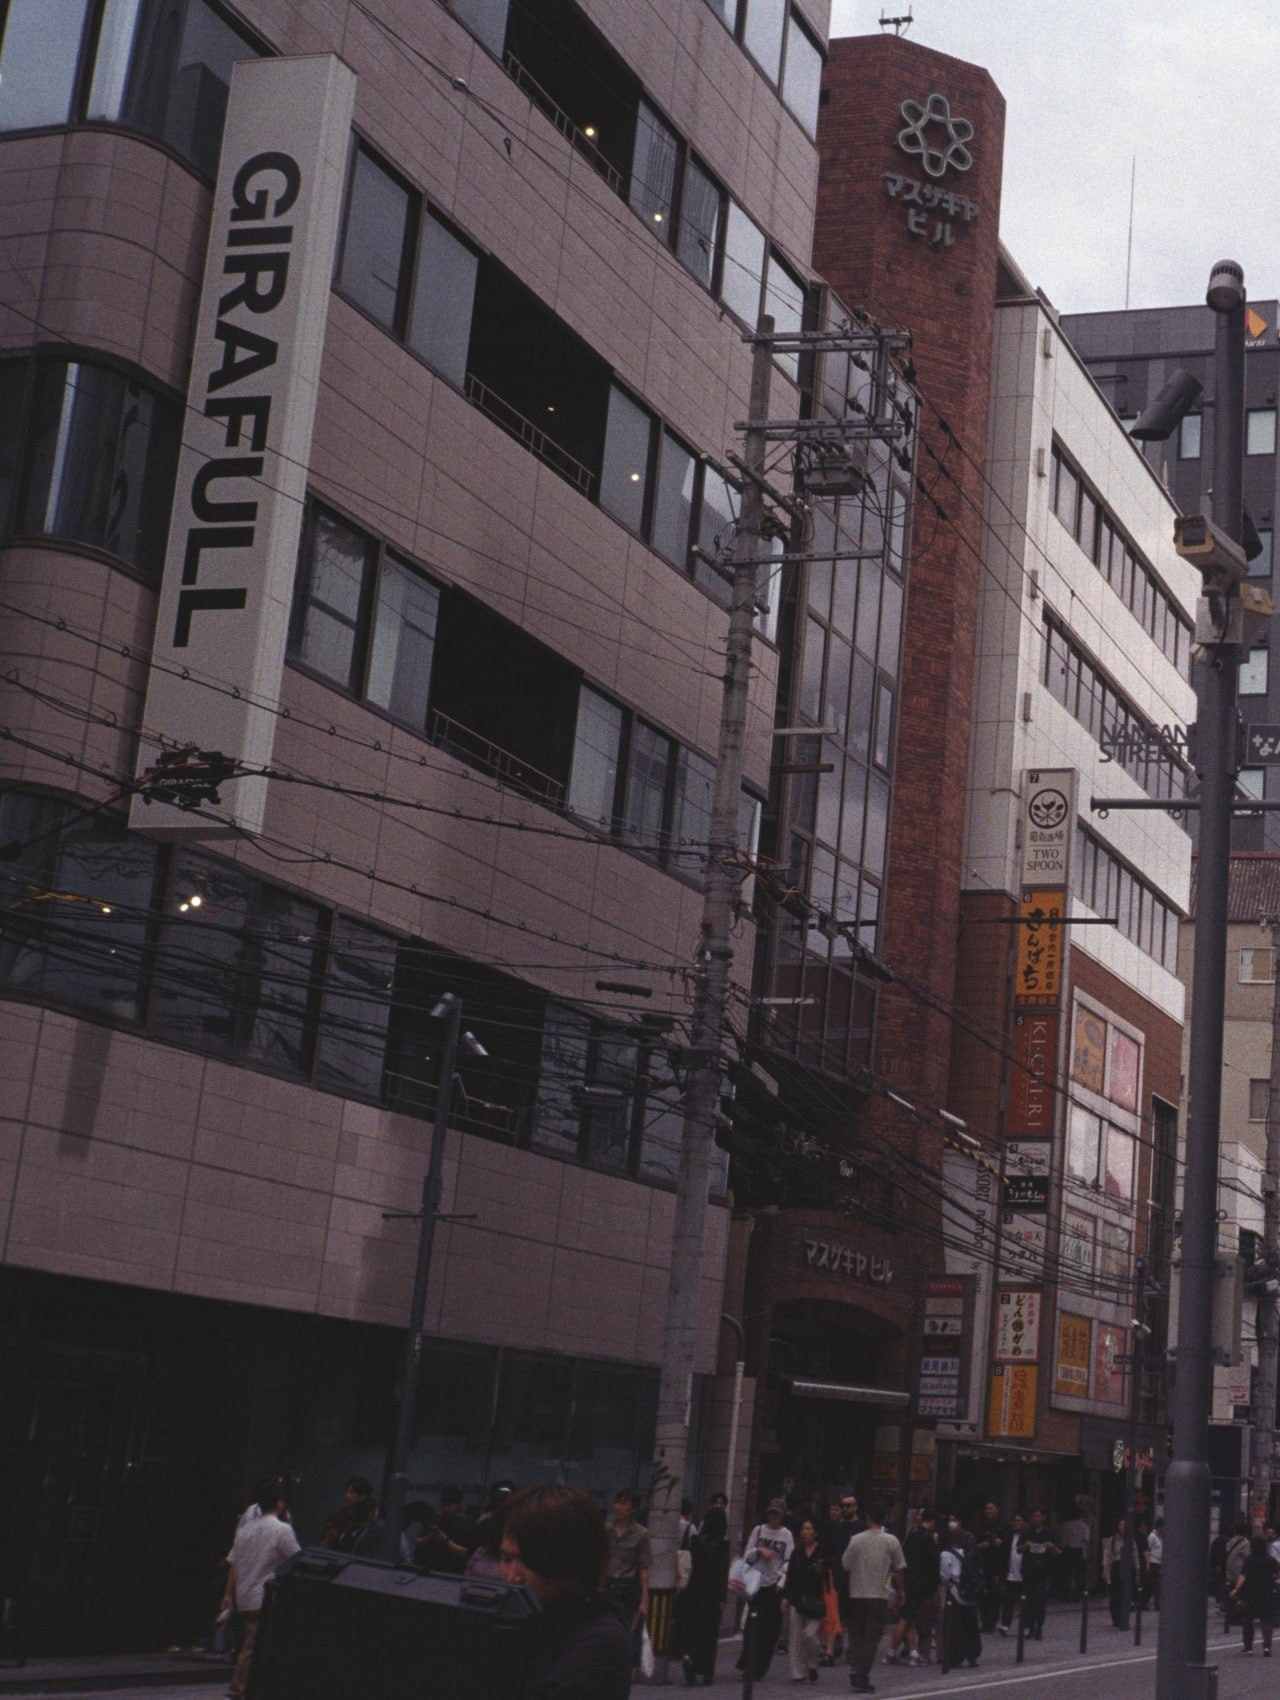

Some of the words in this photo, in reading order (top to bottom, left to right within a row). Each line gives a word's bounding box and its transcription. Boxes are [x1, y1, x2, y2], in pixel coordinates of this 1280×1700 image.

[884, 171, 981, 221] マスザキヤ
[908, 208, 957, 248] ビル
[172, 151, 301, 648] GIRAFULL
[1027, 860, 1063, 871] SPOON
[1033, 850, 1059, 859] TWO
[1017, 1017, 1024, 1025] 5
